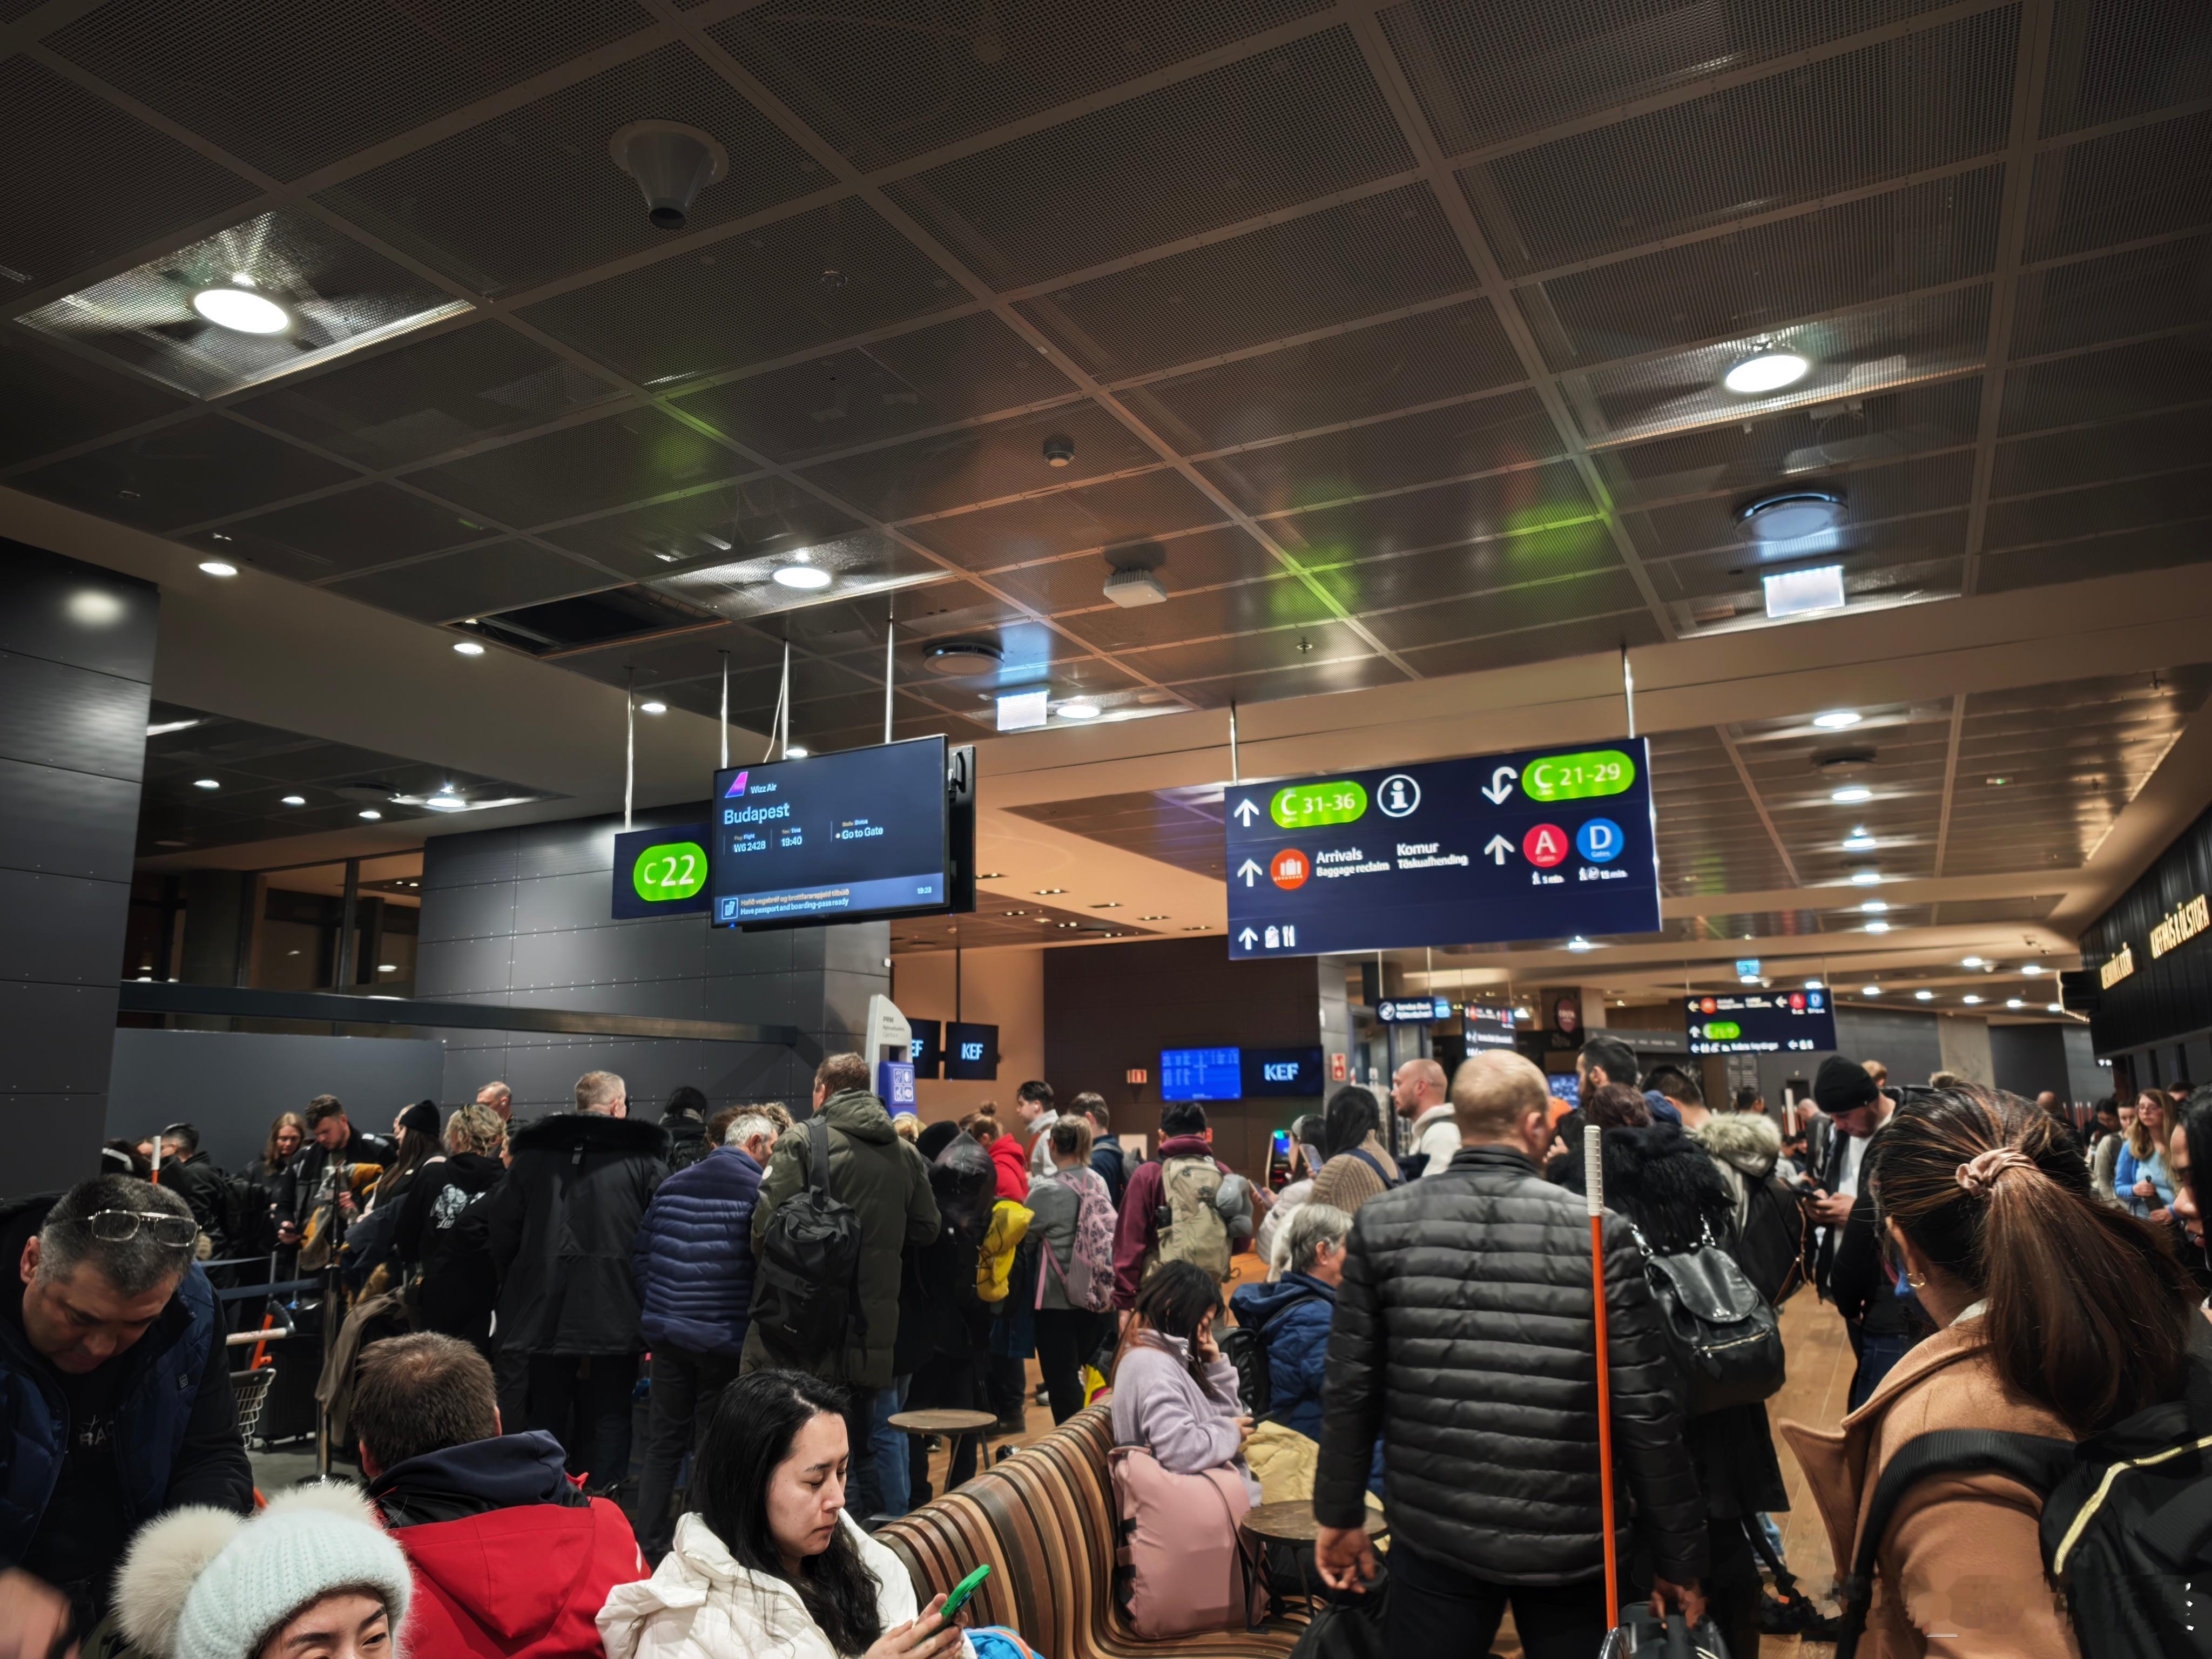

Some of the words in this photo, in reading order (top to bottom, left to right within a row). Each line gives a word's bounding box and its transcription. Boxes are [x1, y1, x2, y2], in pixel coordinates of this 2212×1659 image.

[1534, 764, 1553, 788] C
[1559, 763, 1620, 786] 21-29
[751, 785, 767, 794] Wizz
[767, 783, 777, 791] Air
[724, 802, 790, 825] Budapest
[1280, 794, 1297, 816] C
[1303, 793, 1355, 814] 31-36
[782, 835, 802, 847] 19:40
[842, 830, 854, 839] Go
[854, 830, 863, 838] to
[864, 827, 883, 837] Gate
[1535, 830, 1557, 855] A
[1590, 825, 1613, 850] D
[734, 843, 746, 852] W6
[747, 841, 766, 851] 2428
[1316, 847, 1363, 864] Arrivals
[1397, 842, 1440, 857] Komur
[1316, 866, 1355, 878] Baggage
[1355, 861, 1391, 873] reclaim
[755, 904, 779, 916] passport
[780, 903, 791, 912] and
[832, 897, 849, 906] ready
[912, 1038, 924, 1057] EF
[961, 1042, 984, 1061] KEF
[1264, 1062, 1300, 1081] KEF
